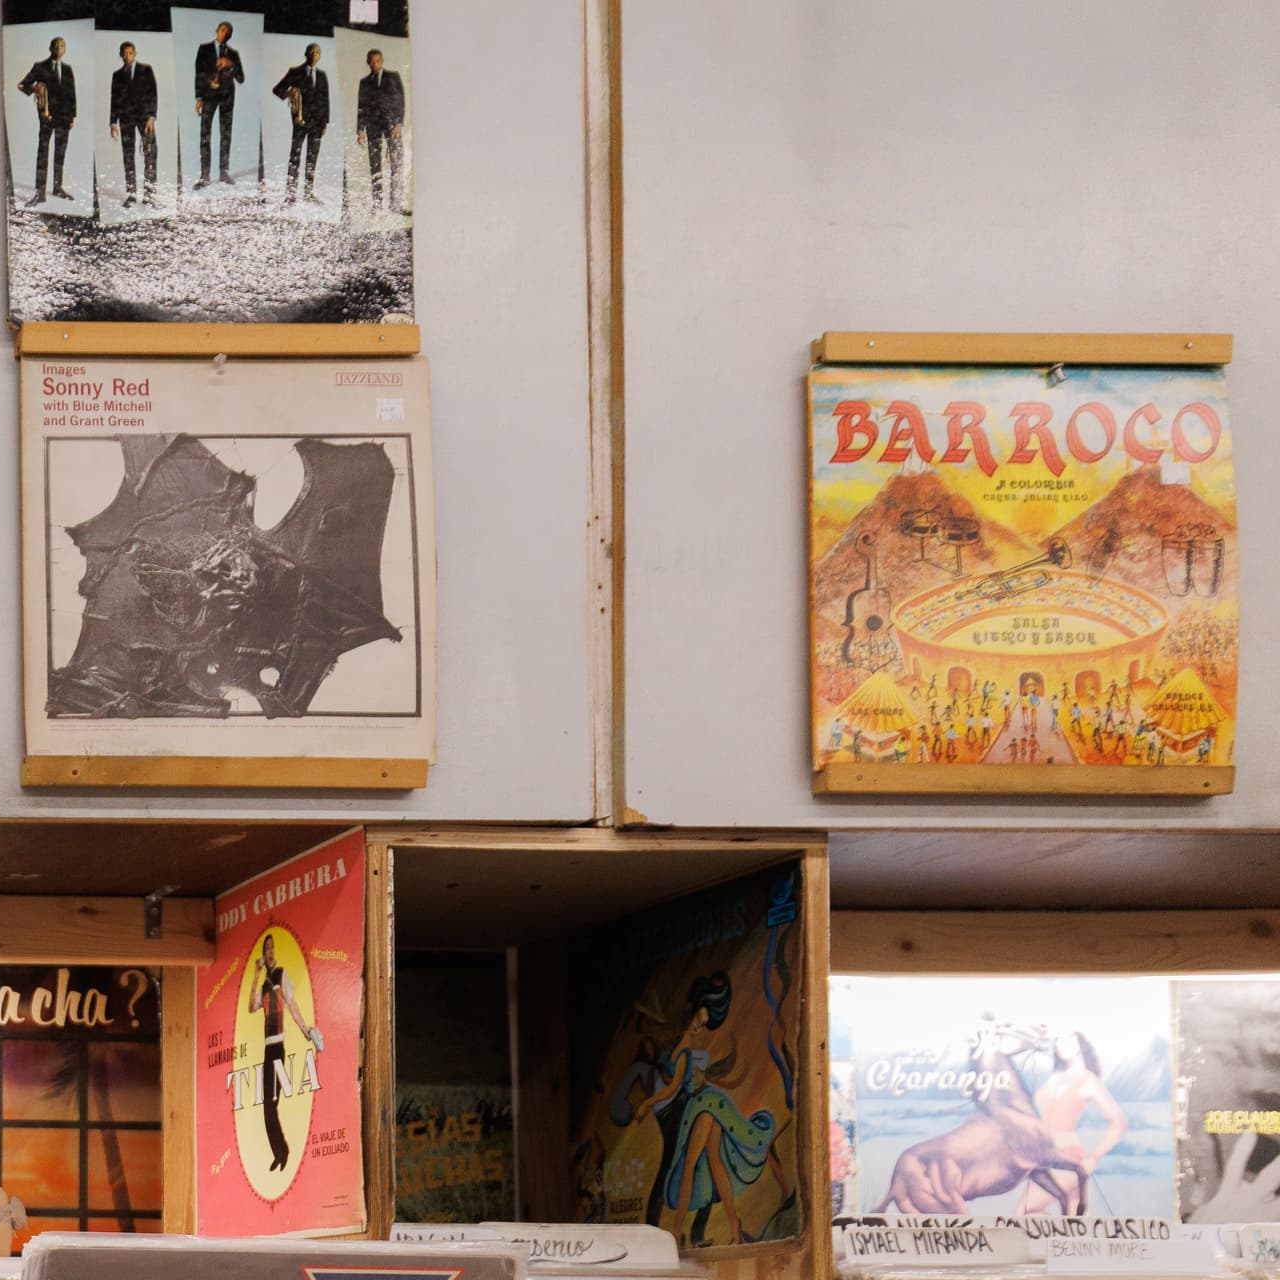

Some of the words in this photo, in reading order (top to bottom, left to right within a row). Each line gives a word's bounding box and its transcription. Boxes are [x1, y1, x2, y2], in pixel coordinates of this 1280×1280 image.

[42, 364, 87, 378] Images
[339, 374, 403, 386] JAZZLAND
[42, 378, 104, 400] Sonny
[112, 378, 150, 396] Red
[43, 401, 69, 413] with
[73, 401, 100, 413] Blue
[104, 401, 153, 413] Mitchell
[43, 415, 66, 427] and
[69, 415, 105, 427] Grant
[108, 415, 145, 427] Green
[828, 399, 1222, 478] BARROCO
[253, 858, 348, 916] CABRERA
[30, 967, 115, 1027] cha
[225, 1048, 323, 1112] TINA
[1094, 1219, 1171, 1241] CLASICO
[851, 1230, 906, 1255] ISMAEL
[912, 1229, 994, 1255] MIRANDA
